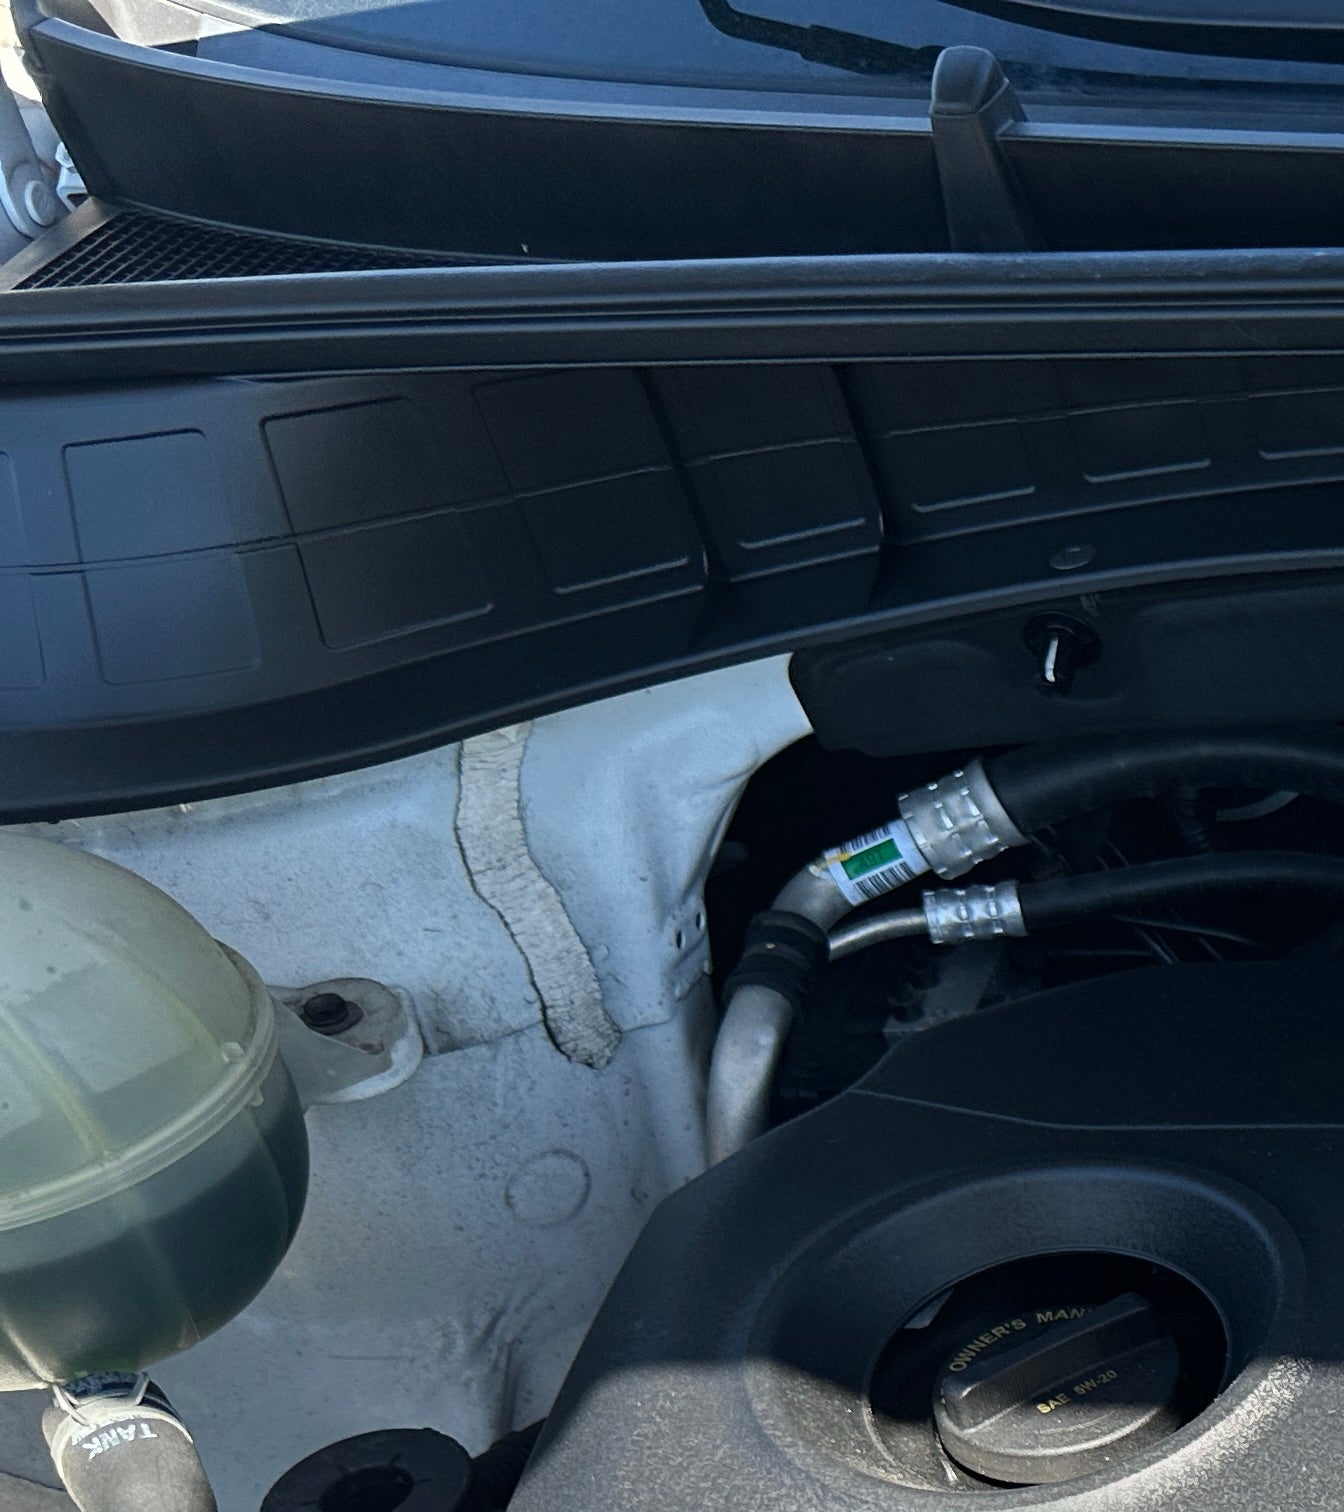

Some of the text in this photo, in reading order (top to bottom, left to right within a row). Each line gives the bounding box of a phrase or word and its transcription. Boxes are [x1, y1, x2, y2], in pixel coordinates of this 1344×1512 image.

[949, 1306, 1092, 1373] OWNER'S MAN
[1036, 1368, 1118, 1415] SAE 5W-20
[82, 1422, 158, 1461] TANK
